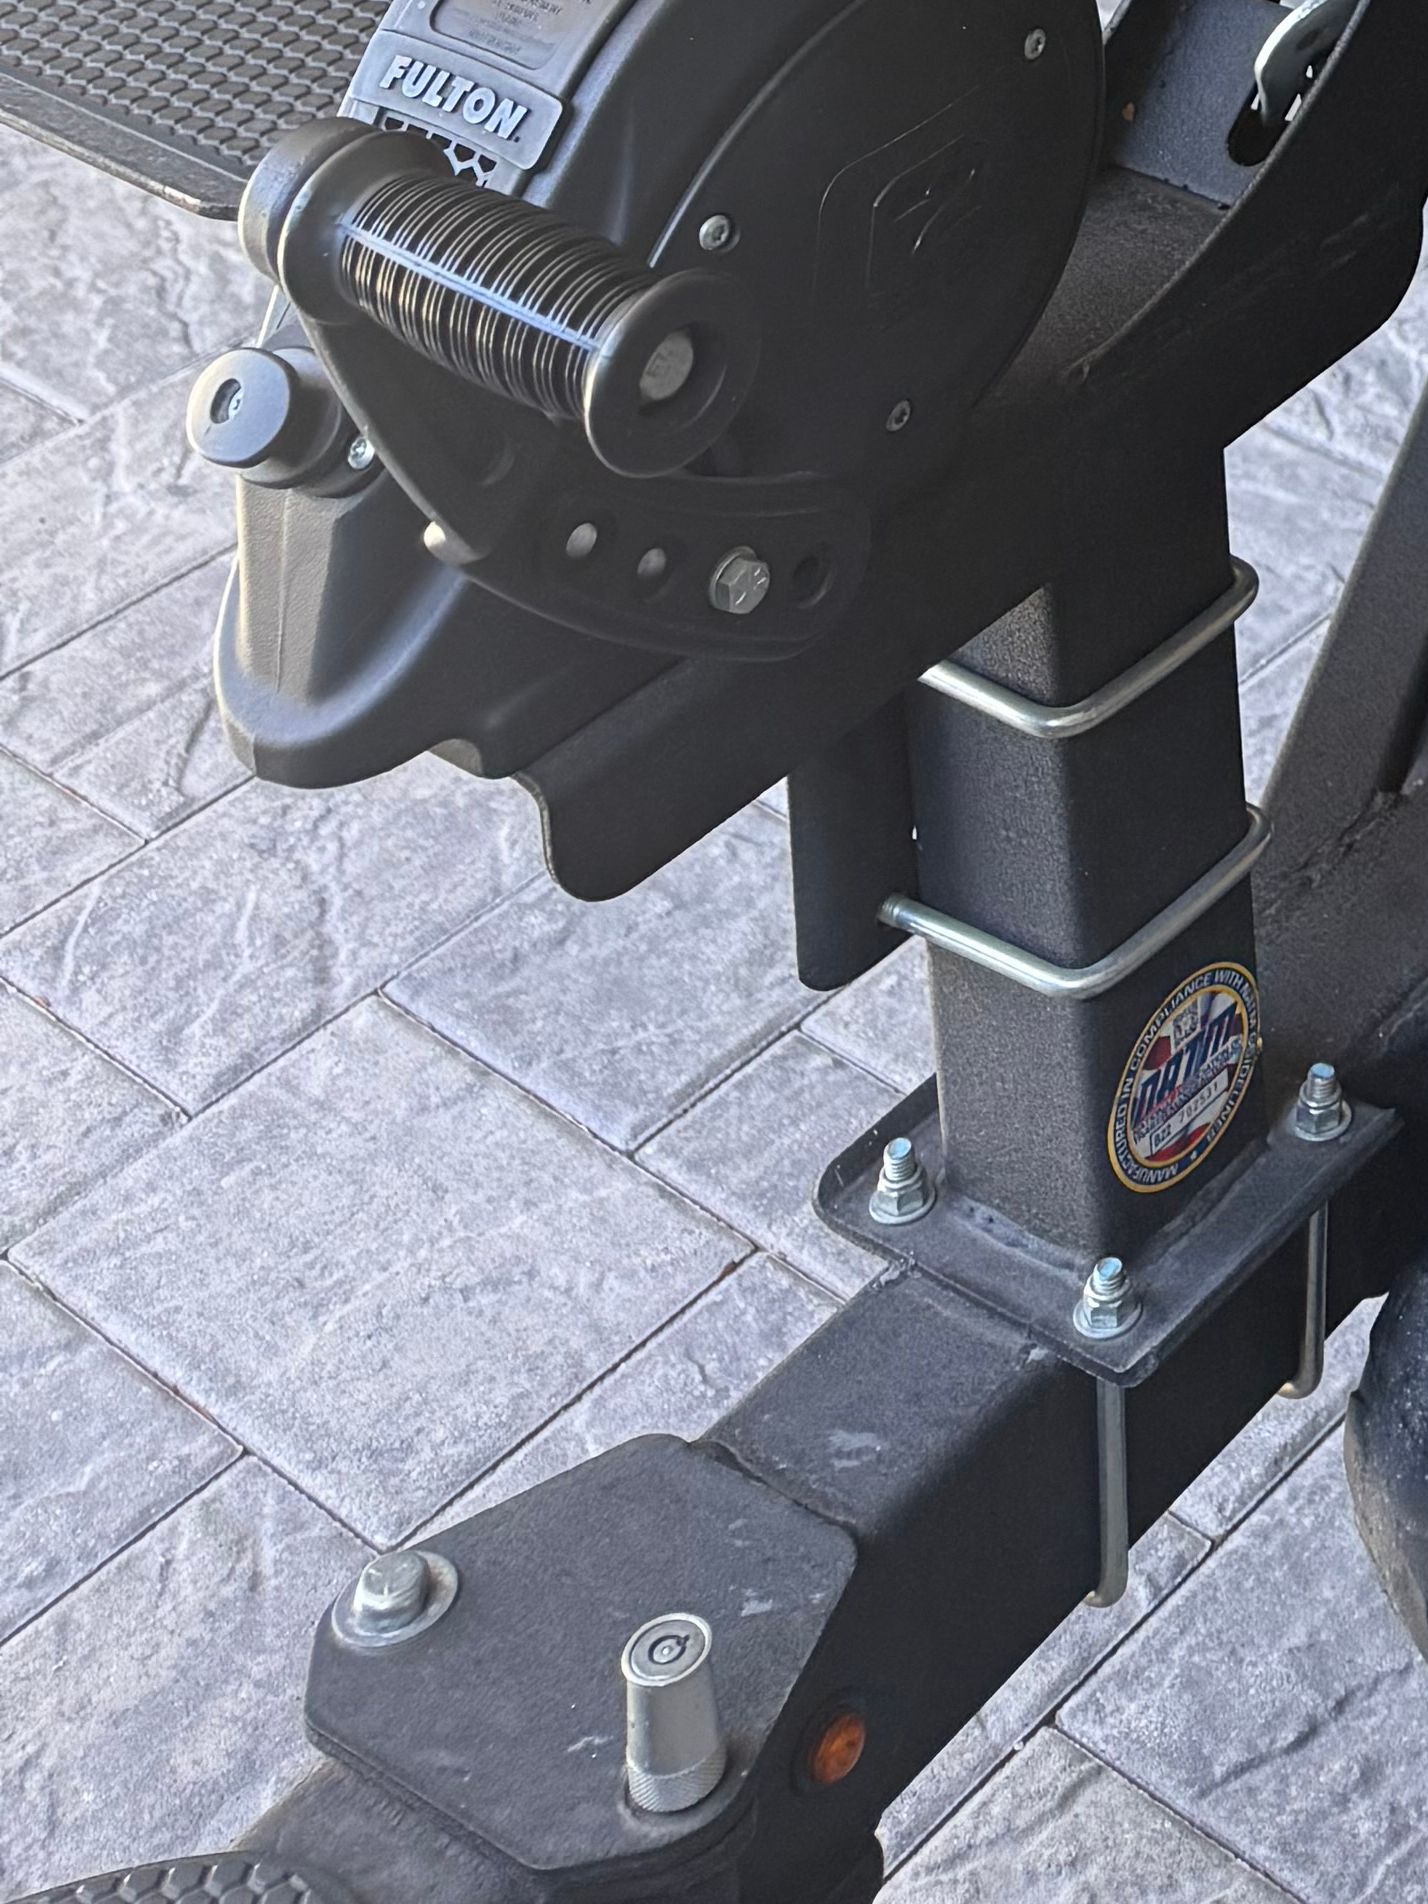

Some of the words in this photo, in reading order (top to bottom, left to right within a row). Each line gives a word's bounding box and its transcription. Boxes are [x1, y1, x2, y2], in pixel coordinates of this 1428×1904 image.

[379, 54, 529, 141] FULTON
[1129, 971, 1212, 1072] COMPLIANCE
[1214, 968, 1244, 989] WITH
